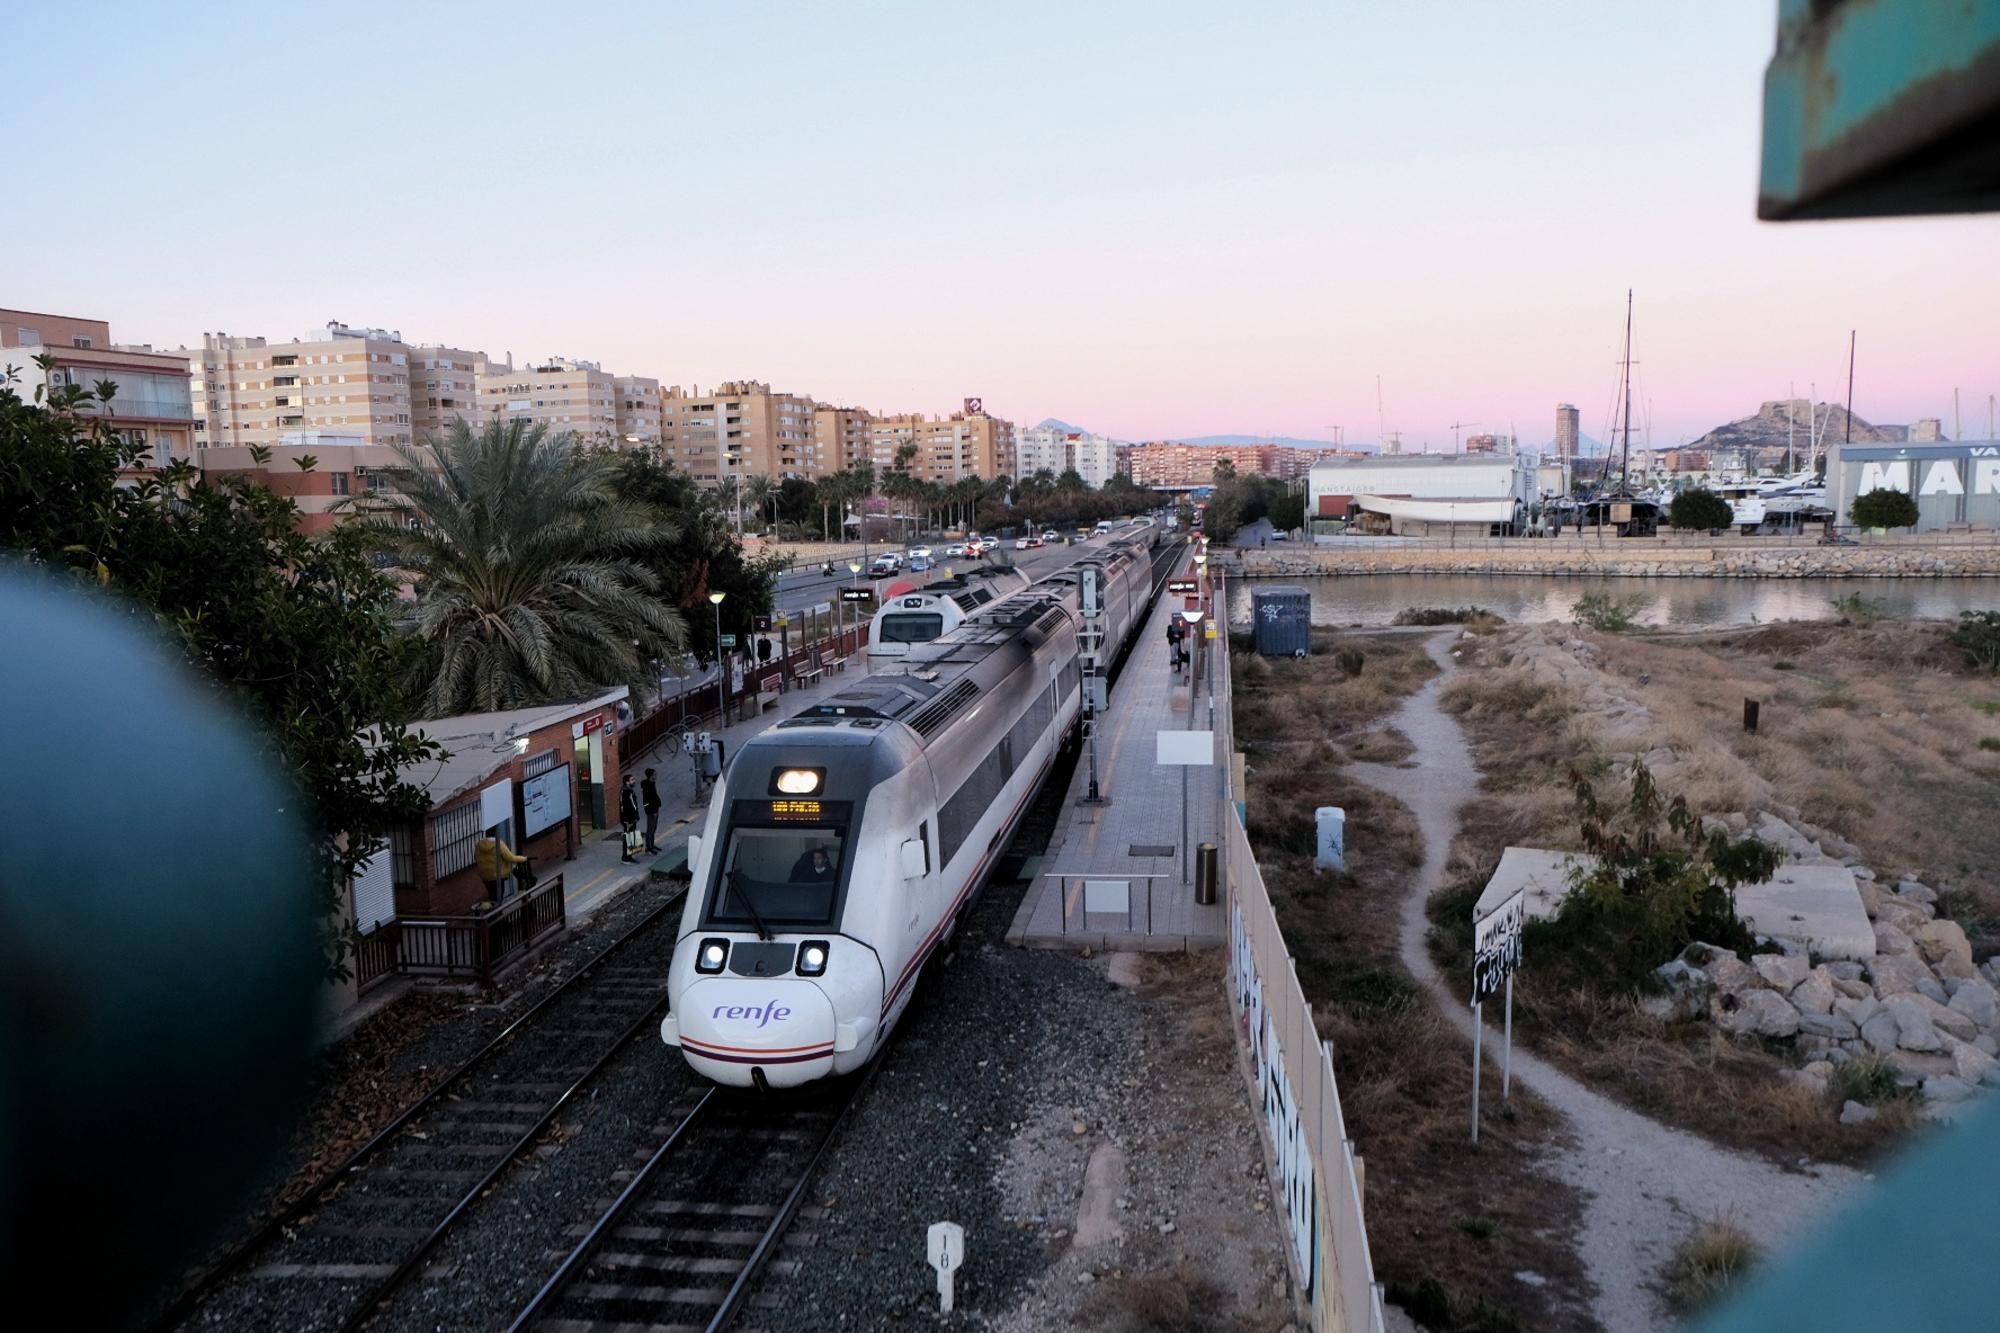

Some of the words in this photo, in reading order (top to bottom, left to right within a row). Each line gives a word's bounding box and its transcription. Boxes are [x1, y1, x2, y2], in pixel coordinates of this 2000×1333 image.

[760, 620, 766, 628] 2
[712, 999, 791, 1028] renfe
[941, 1253, 949, 1269] 8
